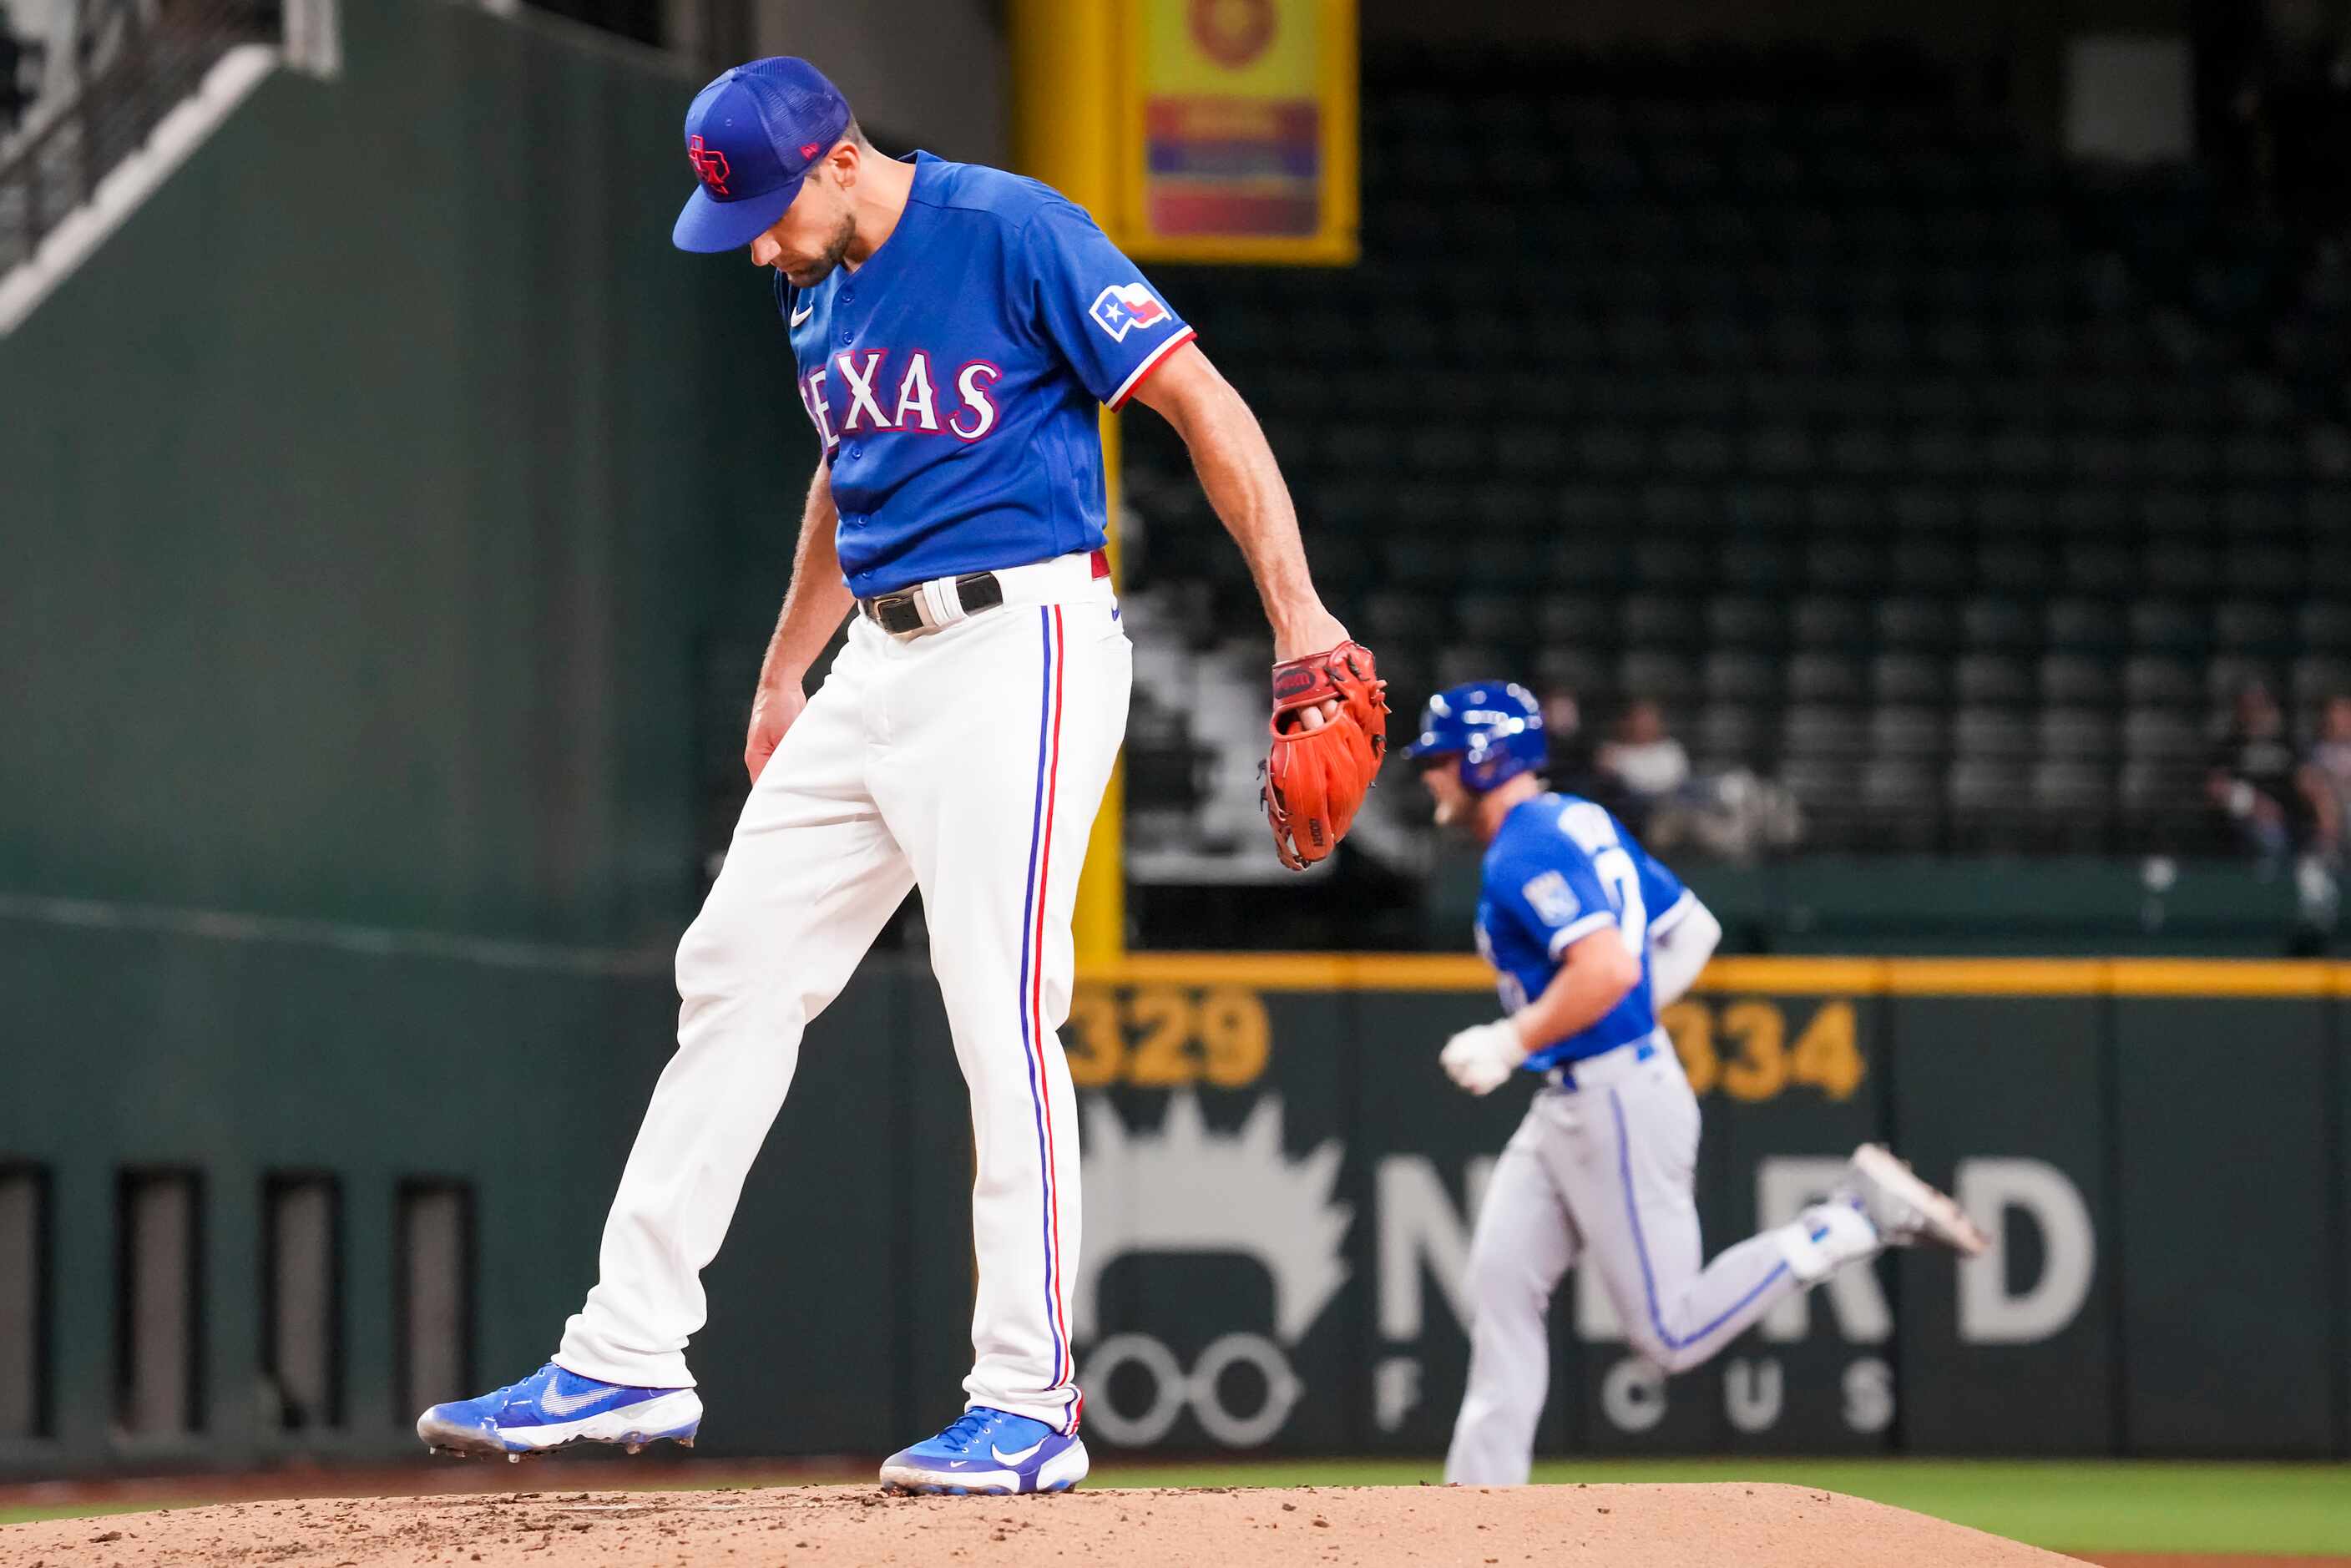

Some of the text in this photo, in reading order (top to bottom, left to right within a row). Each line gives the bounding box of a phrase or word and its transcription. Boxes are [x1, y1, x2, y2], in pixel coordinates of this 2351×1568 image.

[1063, 990, 1272, 1089] 329
[1659, 999, 1868, 1100] 334
[1376, 1155, 2097, 1343] NRD
[1373, 1355, 1895, 1433] FCUS
